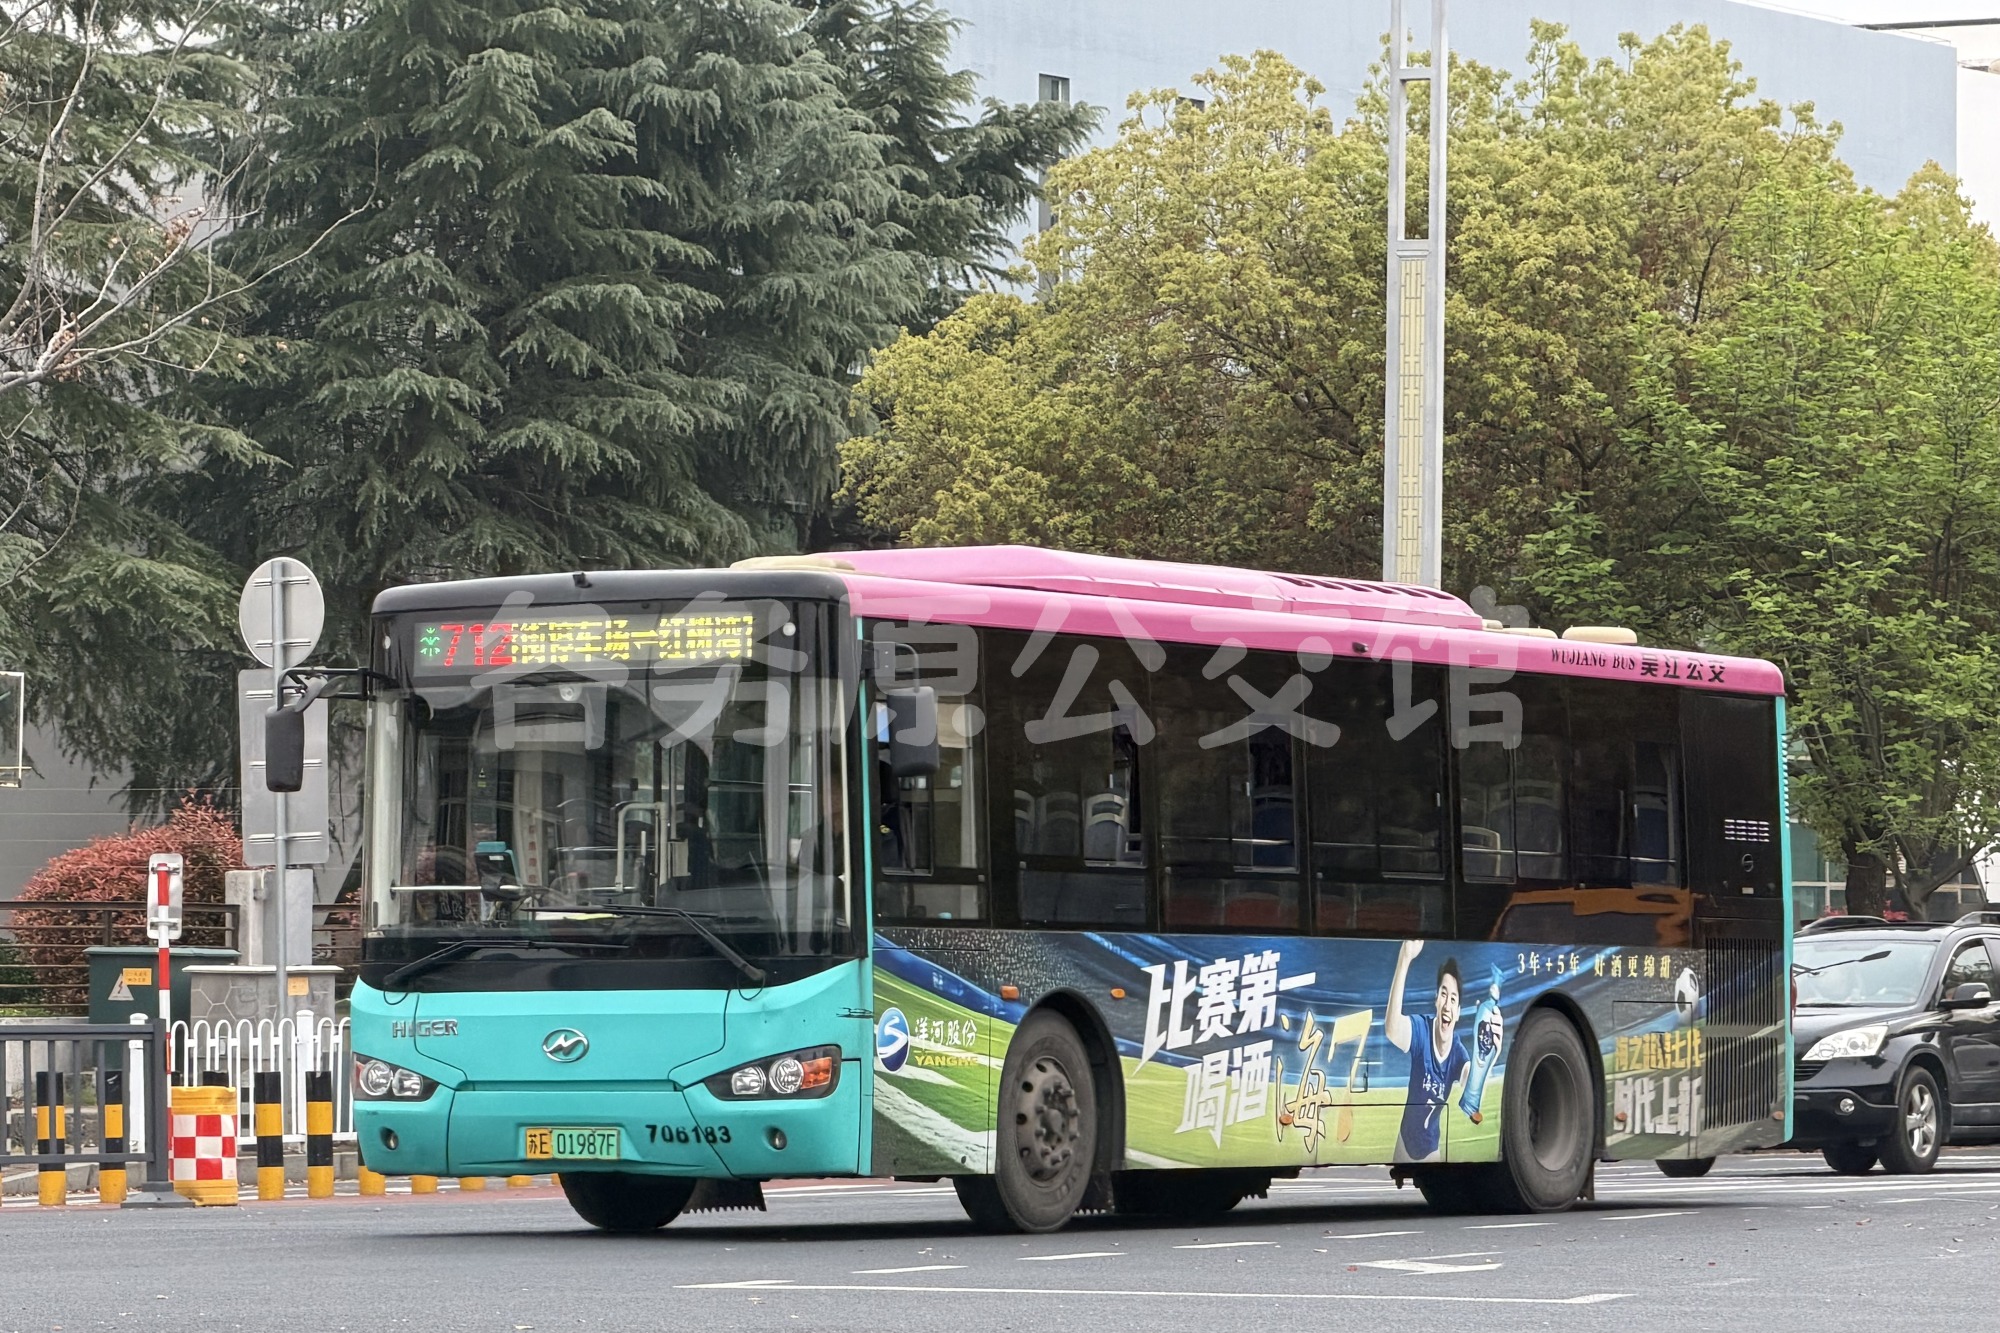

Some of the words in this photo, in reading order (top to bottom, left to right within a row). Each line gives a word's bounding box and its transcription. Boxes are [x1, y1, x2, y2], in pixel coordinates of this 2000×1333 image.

[440, 624, 513, 666] 712
[1551, 648, 1607, 668] WUJIANG
[1612, 653, 1636, 671] BUS
[1641, 652, 1726, 683] 吴江公交
[1517, 951, 1581, 977] 3年+5年
[1594, 954, 1672, 979] 好酒更绵甜
[392, 1018, 459, 1038] HIGER
[1133, 949, 1317, 1076] 比赛第一
[915, 1016, 978, 1052] 洋河股份
[915, 1055, 979, 1067] YANGHE
[1174, 1040, 1275, 1150] 喝酒
[1613, 1075, 1703, 1137] 时代上新
[1423, 1098, 1438, 1130] 7
[645, 1123, 733, 1146] 706183
